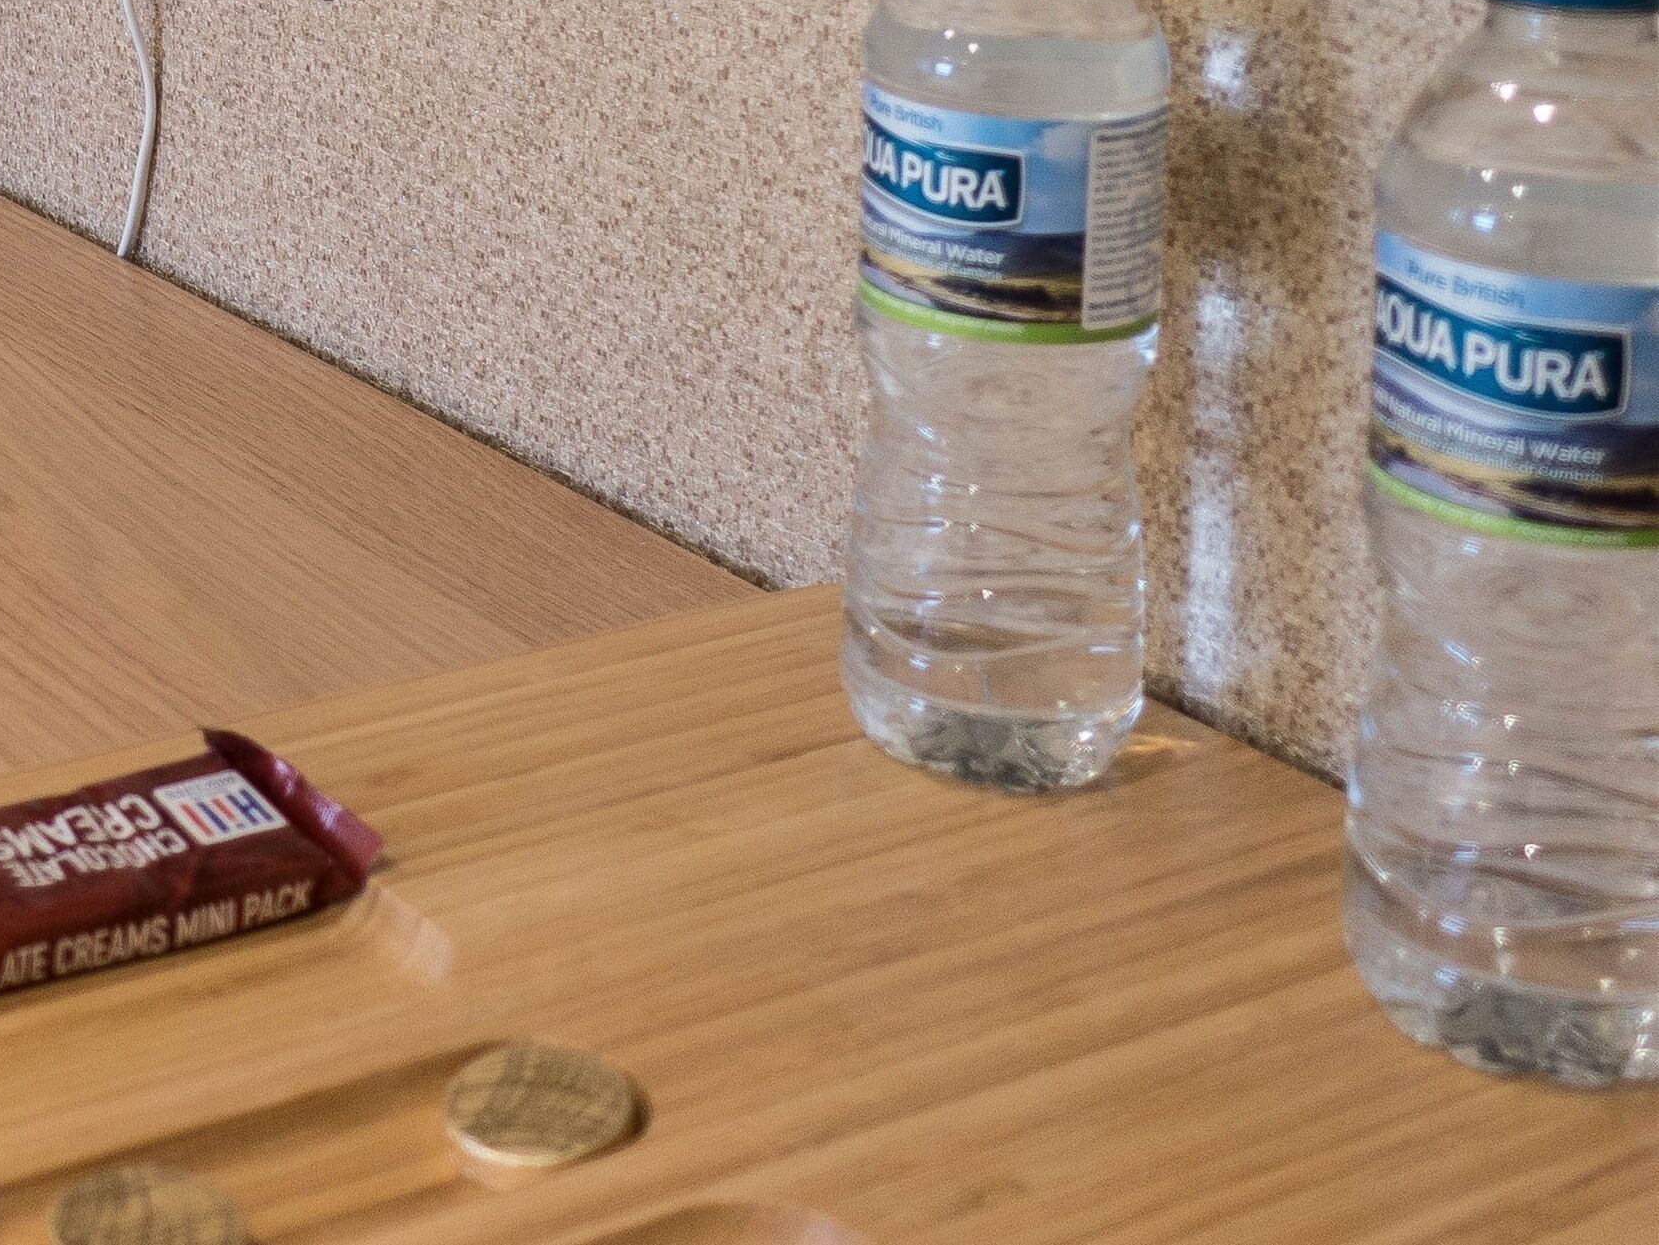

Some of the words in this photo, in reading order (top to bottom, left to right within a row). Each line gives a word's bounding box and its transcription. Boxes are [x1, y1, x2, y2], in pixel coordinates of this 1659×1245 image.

[894, 104, 942, 132] British
[863, 123, 897, 184] UA
[900, 151, 1008, 211] PURA
[889, 228, 942, 255] Mineral
[945, 241, 1005, 266] Water
[1407, 258, 1448, 290] Pure
[1451, 274, 1527, 308] British
[1461, 330, 1609, 402] PURA
[1444, 420, 1525, 455] Mineral
[1529, 439, 1607, 465] Water
[1538, 466, 1604, 483] Cumbria
[2, 827, 188, 888] CHOCOLATE
[56, 917, 170, 971] CREAMS
[177, 901, 238, 945] MINI
[244, 880, 313, 924] PACK
